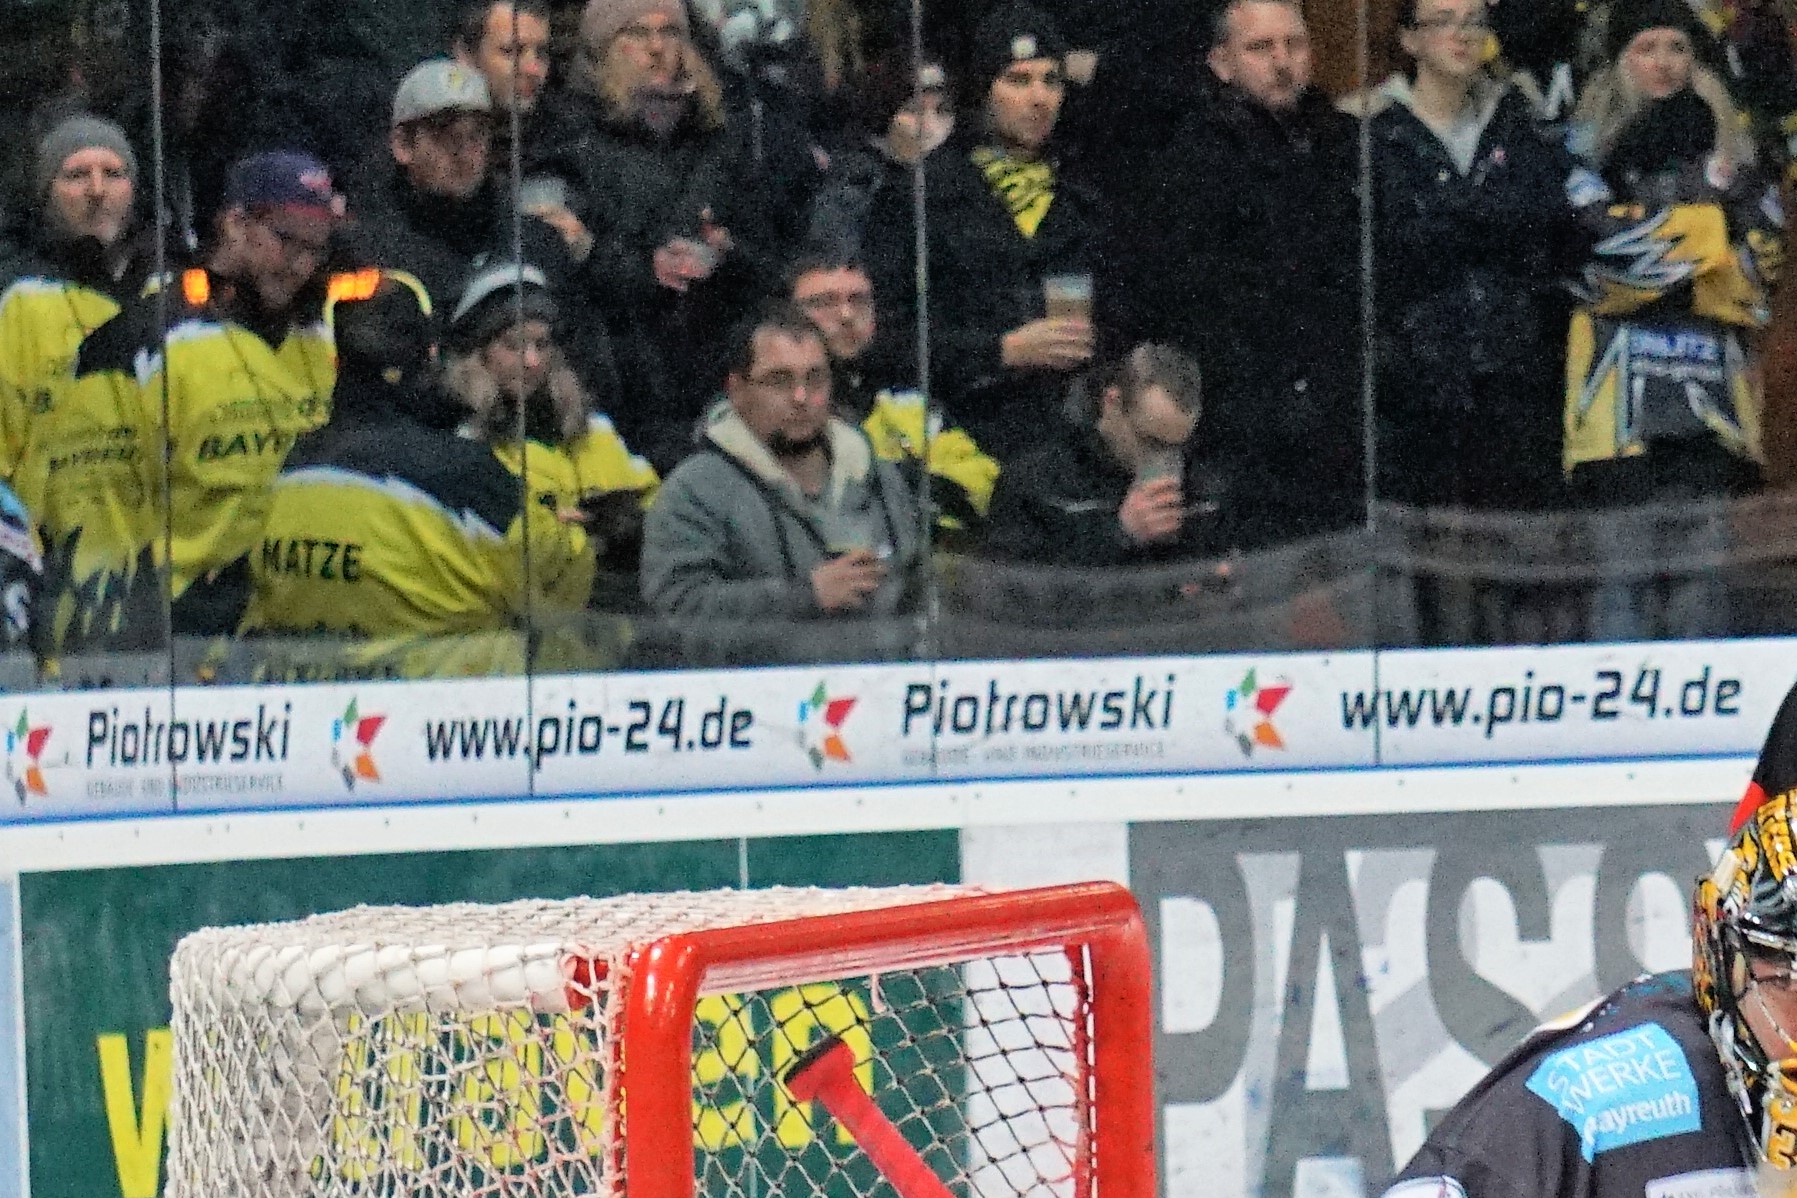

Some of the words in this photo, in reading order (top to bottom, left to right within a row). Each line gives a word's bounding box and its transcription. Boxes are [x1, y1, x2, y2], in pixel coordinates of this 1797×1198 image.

[261, 537, 362, 583] MATZE
[86, 701, 293, 769] Piotrowski
[425, 694, 754, 770] www.pio-24.de
[902, 672, 1178, 737] Piotrowski
[1340, 664, 1743, 740] www.pio-24.de
[1547, 1030, 1656, 1093] STADT
[1561, 1049, 1683, 1115] WERKE
